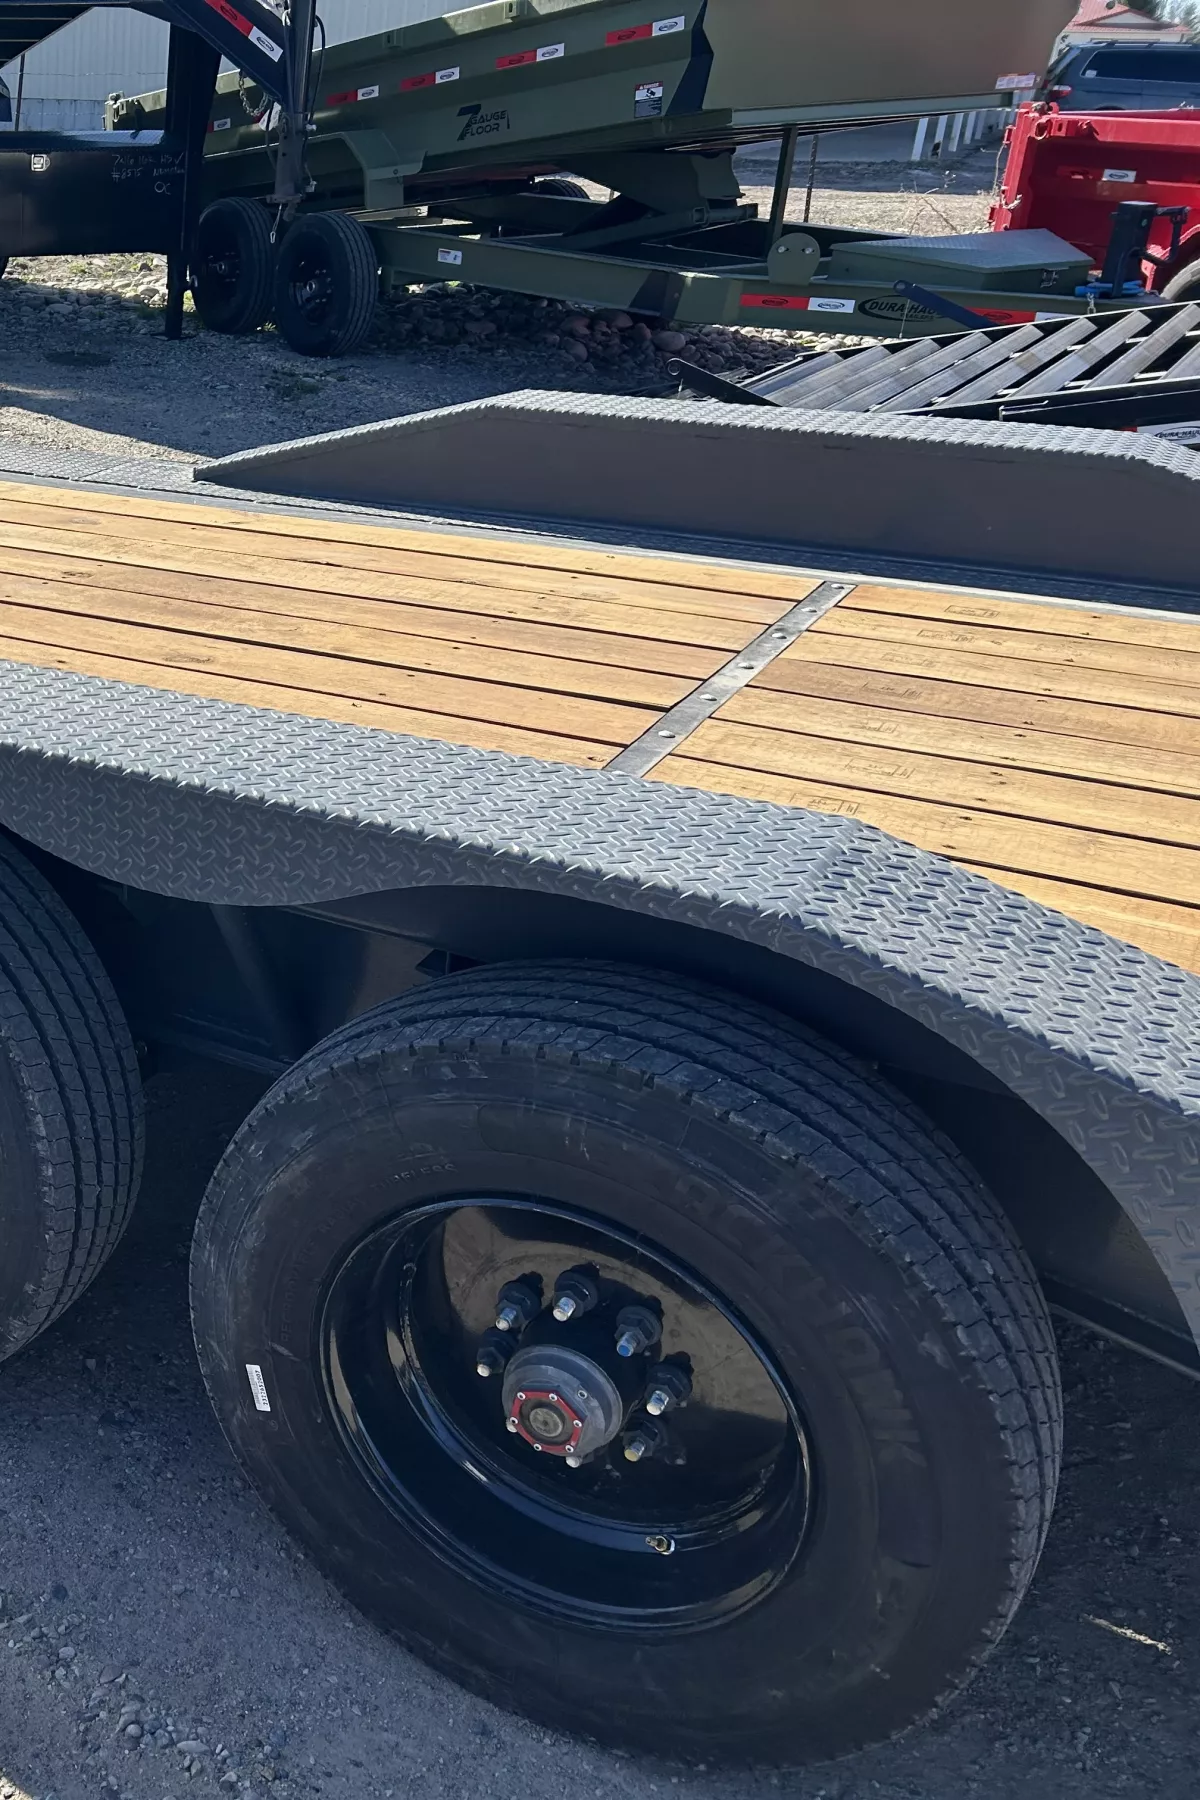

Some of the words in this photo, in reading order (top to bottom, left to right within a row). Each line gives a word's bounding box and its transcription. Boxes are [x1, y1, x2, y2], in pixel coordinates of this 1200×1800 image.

[456, 104, 481, 141] 7
[471, 110, 507, 125] GAUGE
[464, 122, 500, 137] FLOOR
